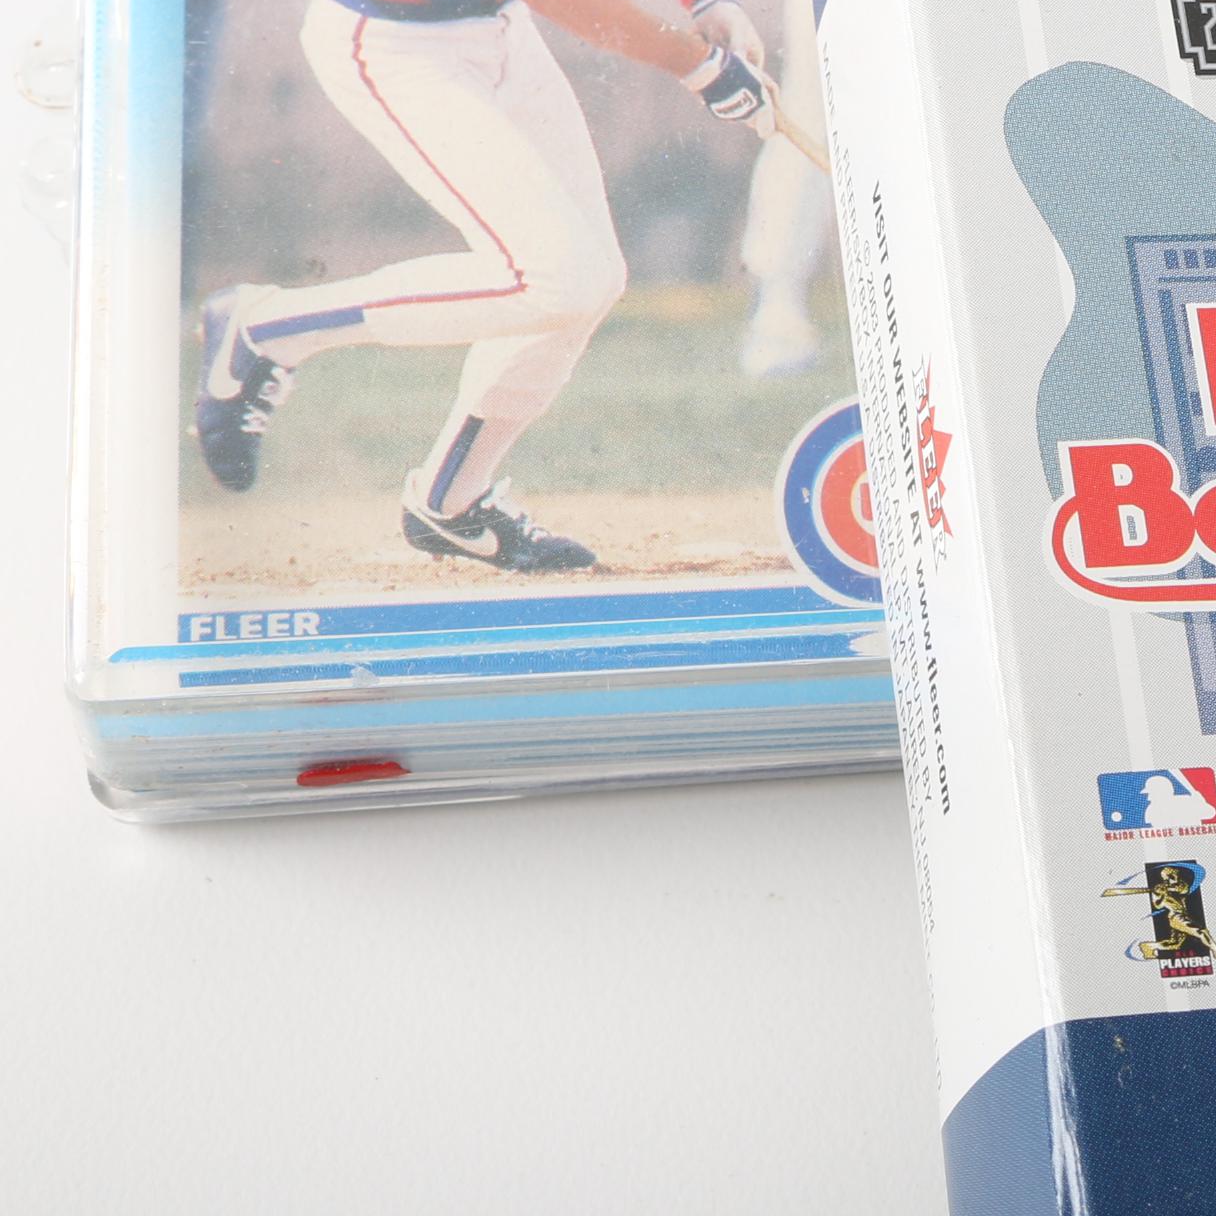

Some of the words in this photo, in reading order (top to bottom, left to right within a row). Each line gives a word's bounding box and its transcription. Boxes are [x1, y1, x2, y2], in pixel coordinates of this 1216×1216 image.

[871, 179, 888, 268] VISIT
[883, 271, 897, 345] OUR
[892, 346, 916, 503] WEBSITE
[866, 271, 879, 334] 2003
[874, 335, 897, 490] PRODUCED
[892, 494, 905, 560] AND
[899, 564, 927, 759] DISTRIBUTED
[922, 764, 932, 807] BY
[910, 505, 921, 549] AT
[190, 611, 321, 642] FLEER
[915, 554, 951, 812] www.fleer.com
[1140, 828, 1173, 839] LEAGUE
[1160, 956, 1210, 969] PLAYERS
